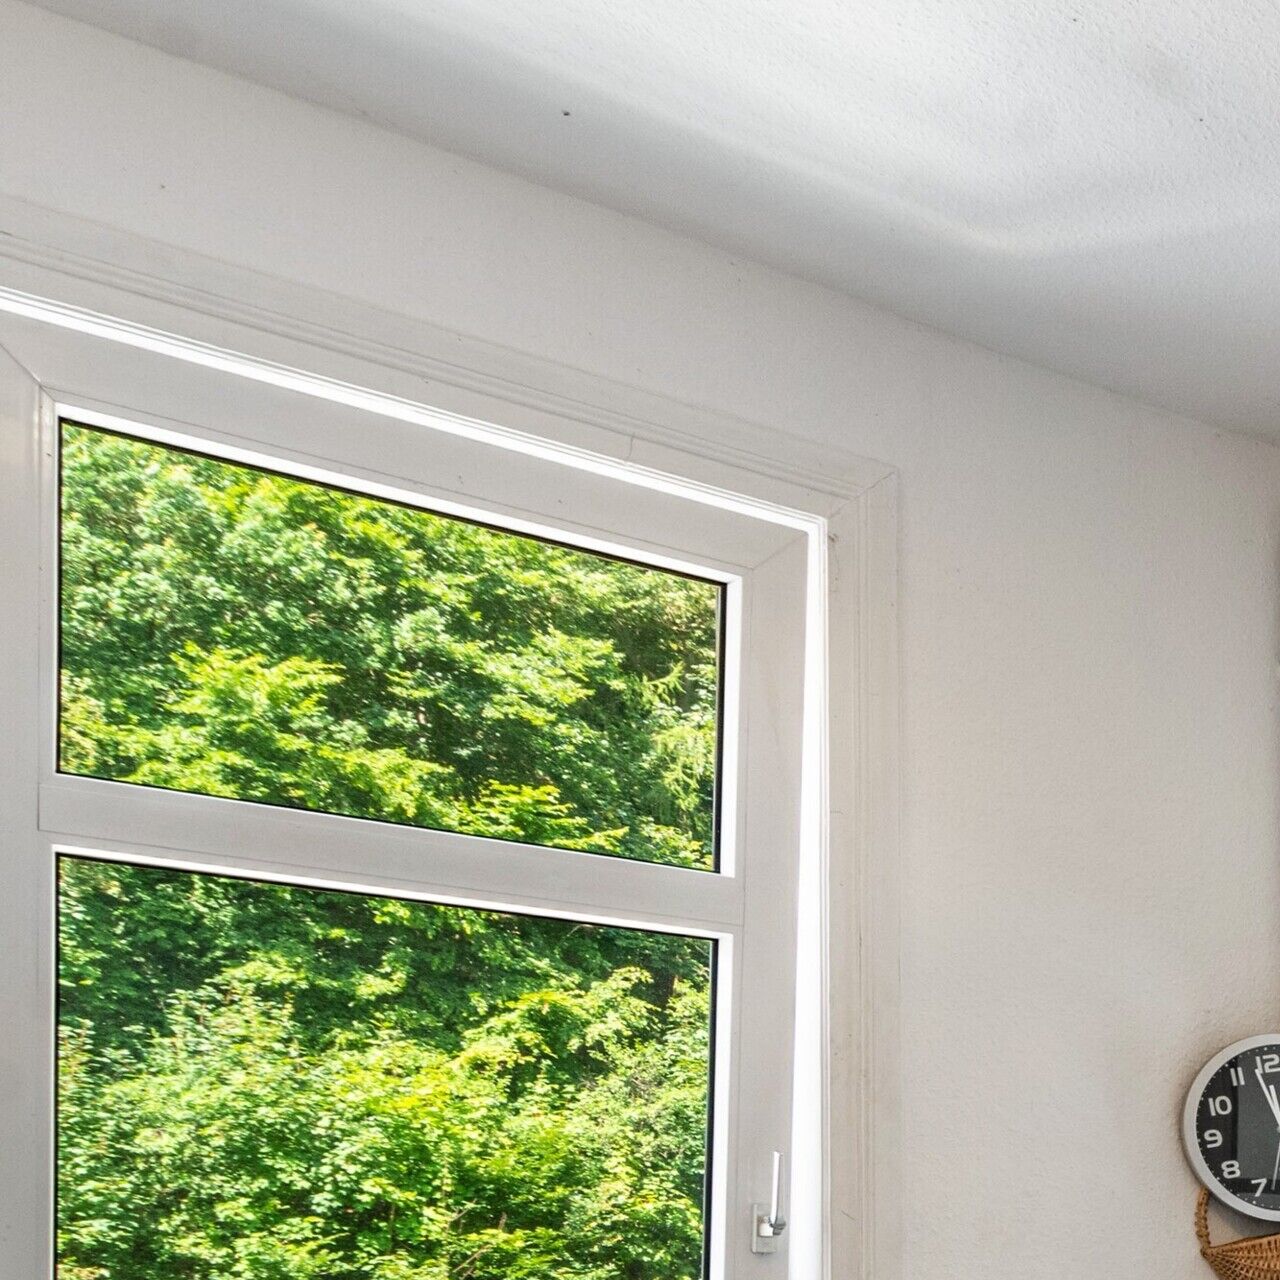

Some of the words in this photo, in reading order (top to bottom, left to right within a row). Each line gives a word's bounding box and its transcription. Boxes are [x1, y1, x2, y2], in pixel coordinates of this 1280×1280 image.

[1255, 1053, 1280, 1074] 12
[1230, 1066, 1245, 1087] 11
[1208, 1095, 1233, 1117] 10
[1203, 1129, 1223, 1149] 9
[1221, 1160, 1241, 1179] 8
[1251, 1178, 1268, 1197] 7
